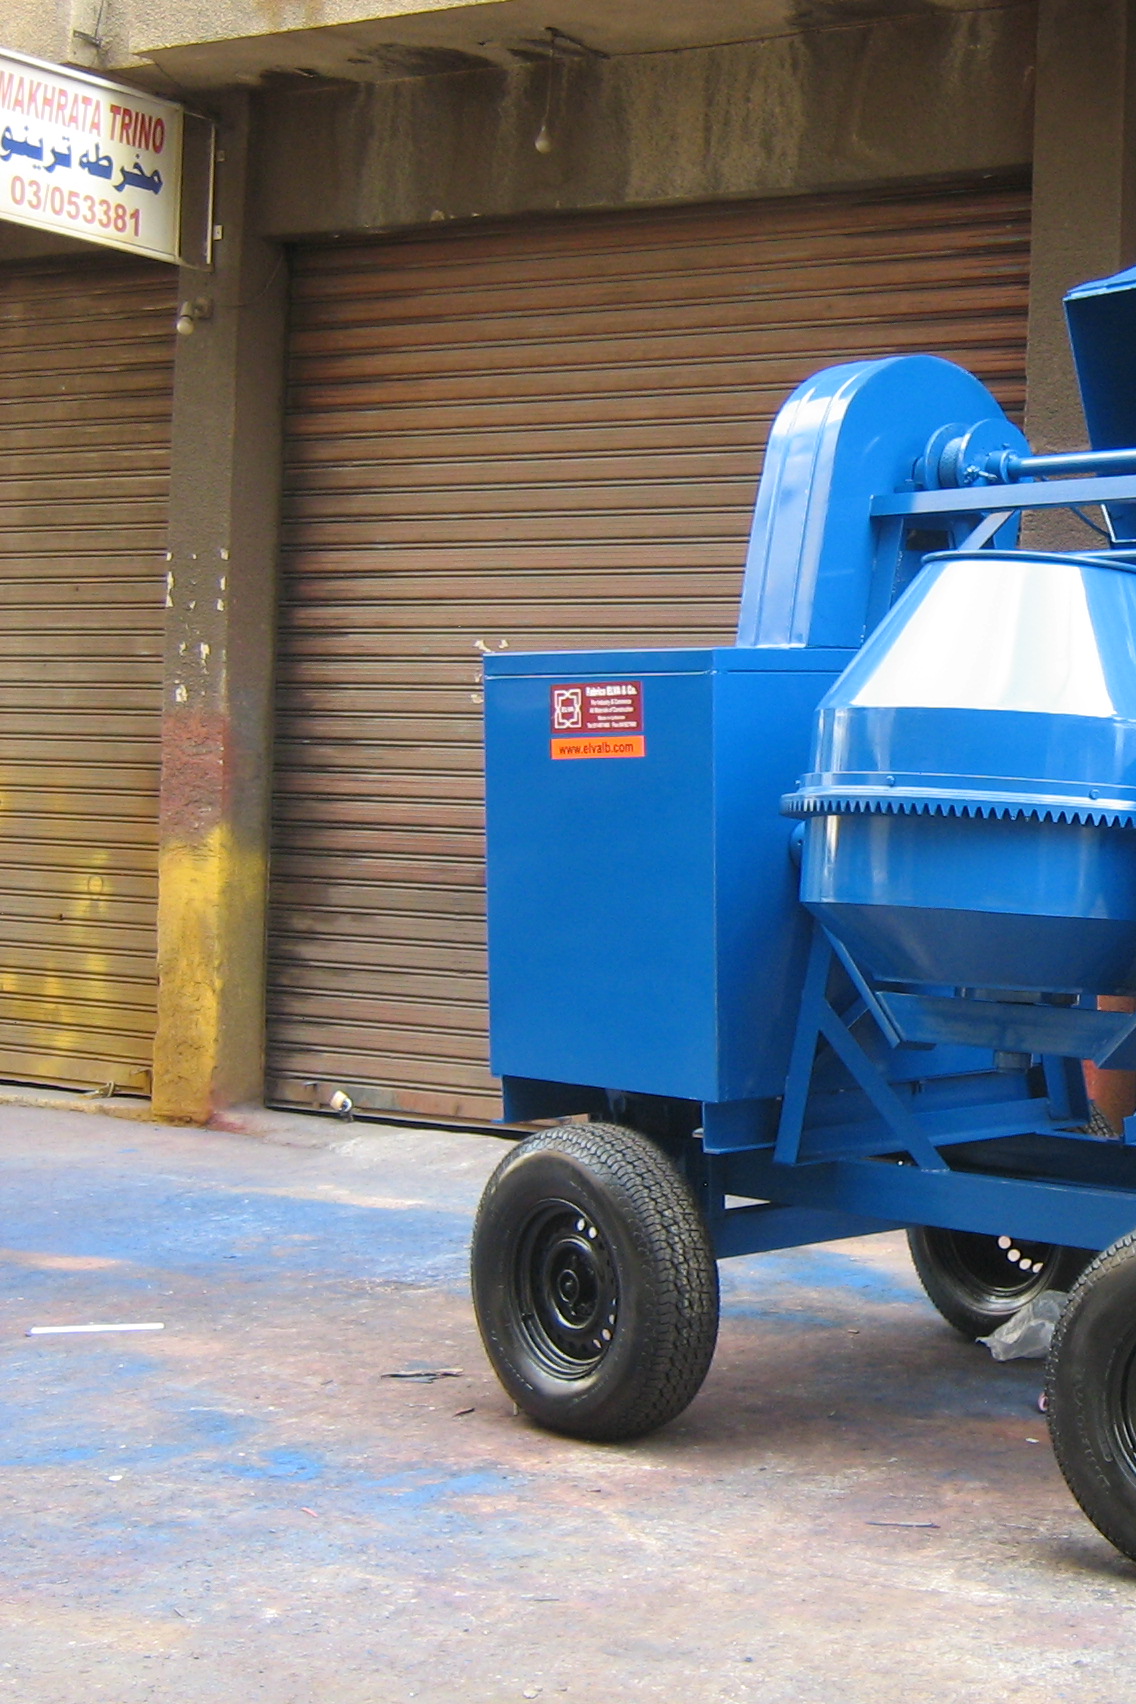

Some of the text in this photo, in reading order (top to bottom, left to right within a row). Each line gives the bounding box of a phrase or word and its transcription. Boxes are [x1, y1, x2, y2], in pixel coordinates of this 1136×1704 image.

[0, 71, 165, 154] MAKHRATA TRINO
[10, 174, 141, 237] 03/053381
[559, 742, 634, 754] www.elvalb.com
